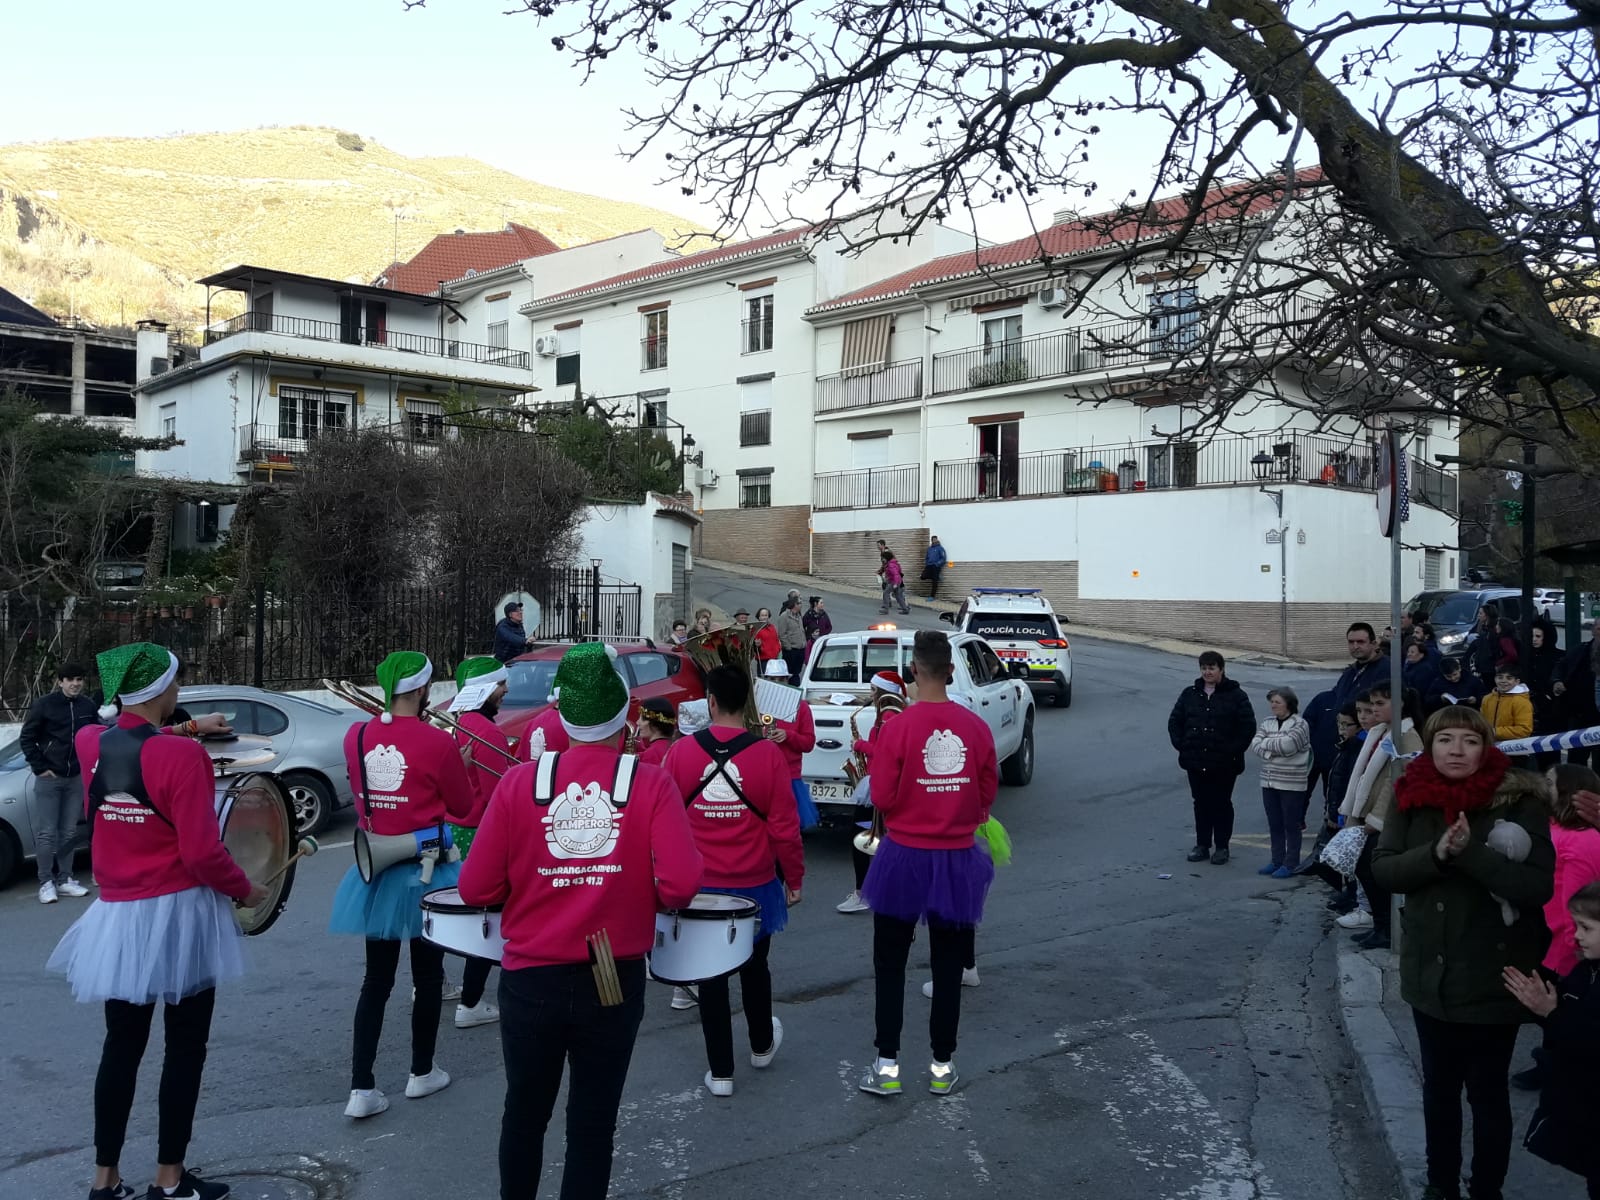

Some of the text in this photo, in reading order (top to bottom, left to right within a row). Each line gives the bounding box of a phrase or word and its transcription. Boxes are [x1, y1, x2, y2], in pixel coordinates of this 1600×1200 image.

[977, 625, 1048, 636] POLICÍA LOCAL
[811, 785, 837, 798] 8372
[571, 806, 595, 819] LOS
[553, 818, 612, 831] CAMPEROS
[552, 878, 571, 888] 692
[572, 876, 585, 885] 43
